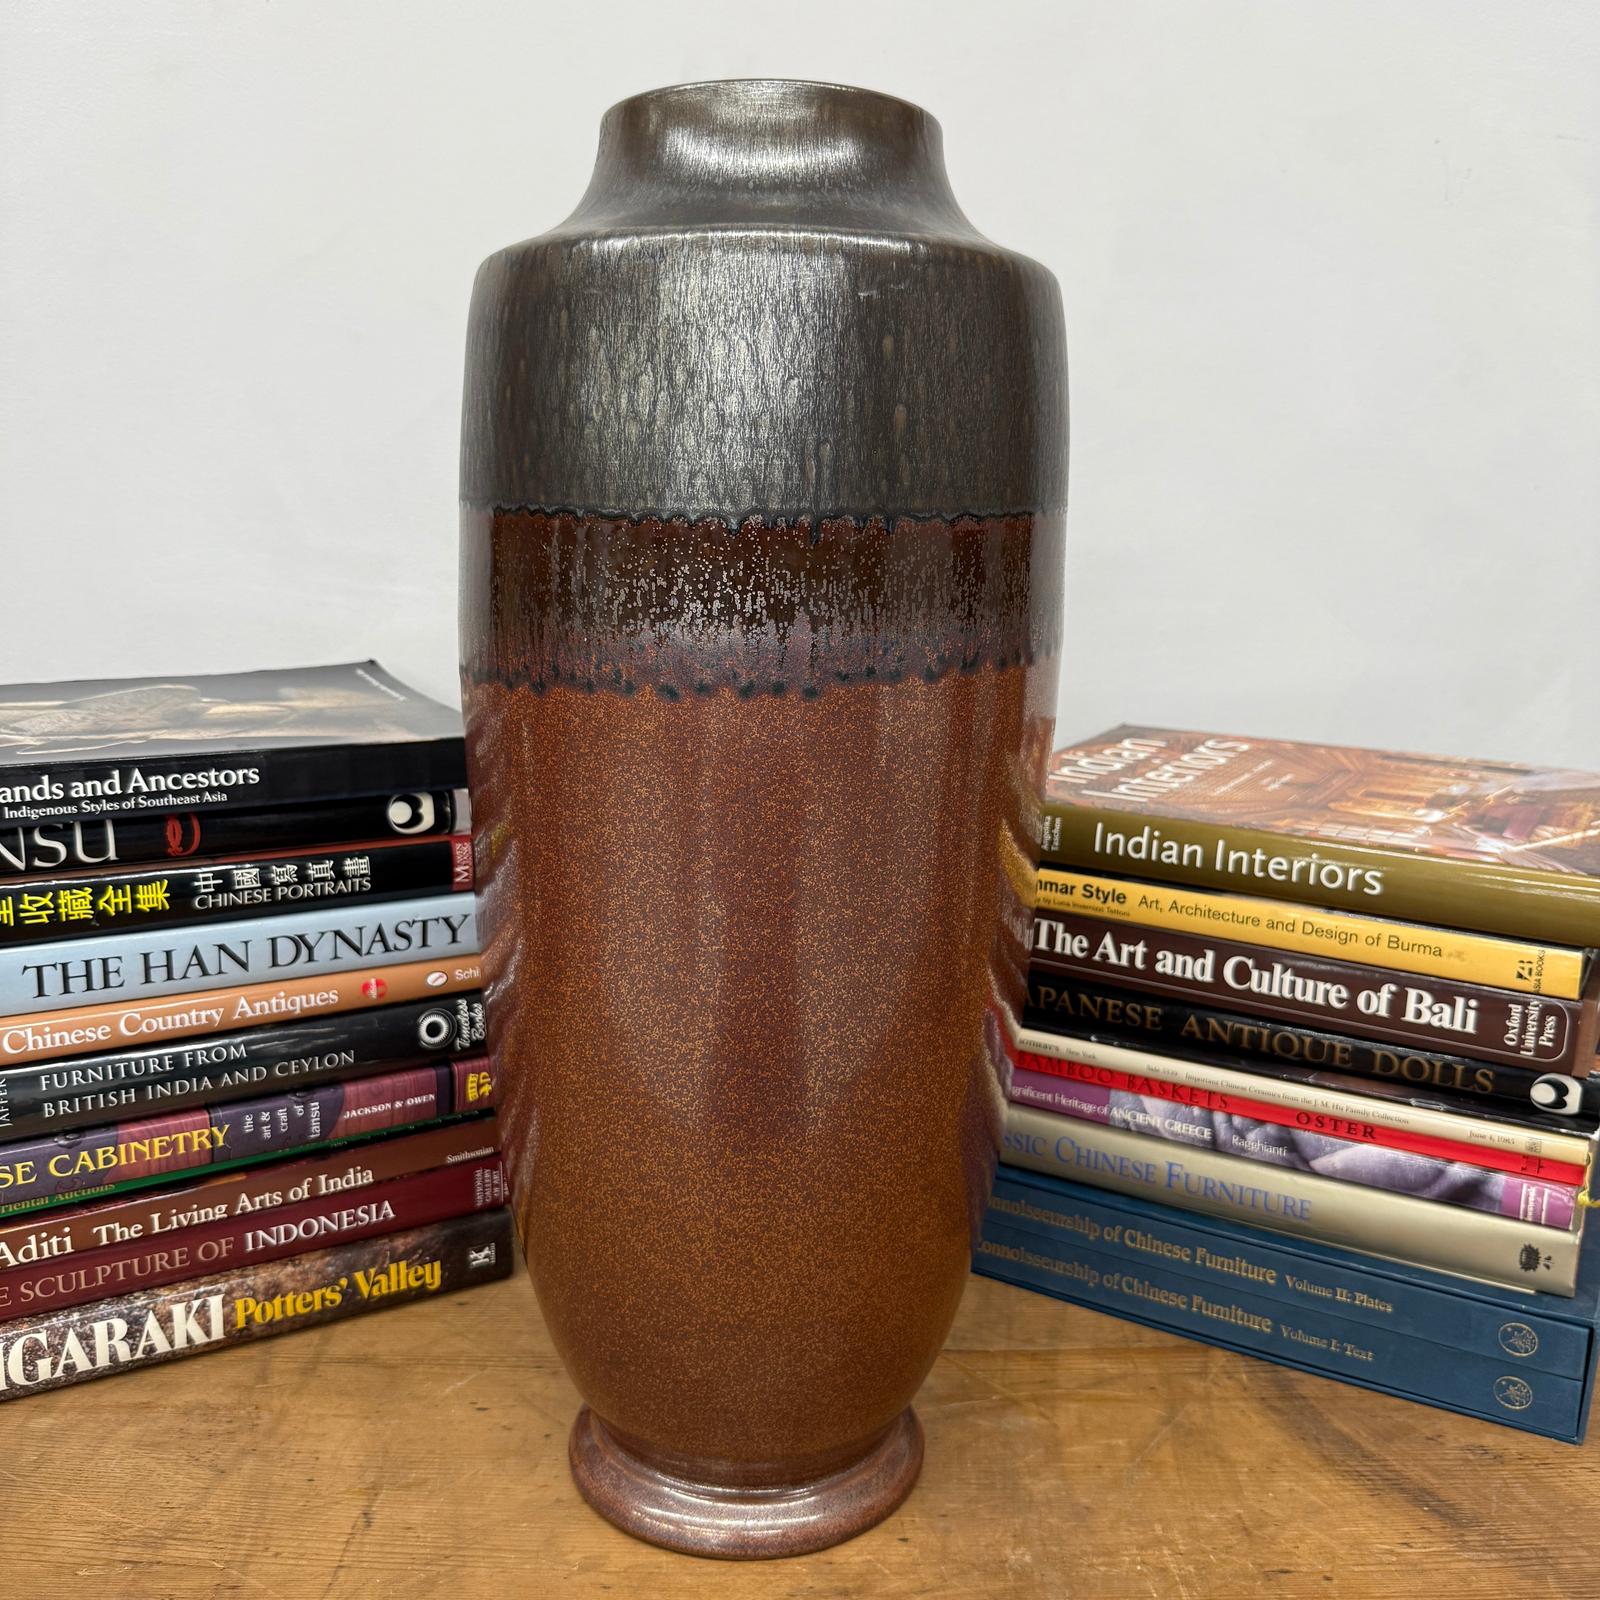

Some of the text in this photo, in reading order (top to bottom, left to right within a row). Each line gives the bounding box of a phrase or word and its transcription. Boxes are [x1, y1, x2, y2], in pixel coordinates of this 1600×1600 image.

[0, 766, 260, 804] ands and Ancestors
[1048, 738, 1168, 784] Indian
[1080, 738, 1250, 802] Interiors
[4, 791, 228, 820] Indigenous Styles of Southeast Asia
[1094, 822, 1384, 896] Indian Interiors
[194, 876, 372, 910] CHINESE PORTRAITS
[1082, 883, 1127, 904] Style
[1138, 895, 1443, 957] Art, Architecture and Design of Burma
[21, 913, 471, 999] THE HAN DYNASTY
[1035, 917, 1481, 1035] The Art and Culture of Bali
[3, 990, 340, 1055] Chinese Country Antiques
[454, 997, 470, 1050] Timeless
[470, 1003, 485, 1041] Books
[1503, 1003, 1523, 1046] Oxford
[1520, 1000, 1544, 1057] University
[1538, 1015, 1557, 1047] Press
[40, 1044, 248, 1091] FURNITURE FROM
[1180, 1013, 1353, 1068] ANTIQUE
[1371, 1050, 1495, 1095] DOLLS
[43, 1049, 355, 1118] BRITISH INDIA AND CEYLON
[344, 1093, 436, 1119] JACKSON & OWEN
[1017, 1050, 1377, 1140] BAMBOO BASKETS OSTER
[244, 1113, 254, 1133] the
[260, 1111, 271, 1140] art &
[277, 1108, 288, 1132] craft
[294, 1104, 304, 1117] of
[308, 1101, 320, 1139] tansu
[1054, 1092, 1097, 1114] Heritage
[1097, 1104, 1110, 1115] of
[1110, 1106, 1161, 1128] ANCIENT
[1164, 1118, 1212, 1140] GREECE
[0, 1124, 230, 1188] SE CABINETRY
[446, 1144, 495, 1164] Smithsonian
[1055, 1136, 1157, 1185] CHINESE
[1166, 1161, 1312, 1221] FURNITURE
[92, 1166, 374, 1246] The Living Arts of India
[0, 1227, 76, 1269] Aditi
[20, 1247, 190, 1302] SCULPTURE
[198, 1236, 235, 1262] OF
[244, 1199, 396, 1251] INDONESIA
[1103, 1225, 1123, 1242] of
[1124, 1228, 1191, 1263] Chinese
[1195, 1247, 1277, 1284] Furniture
[1285, 1275, 1332, 1297] Volume
[1335, 1287, 1352, 1302] II:
[1354, 1292, 1393, 1313] Plates
[234, 1259, 442, 1329] Potters' Valley
[977, 1241, 1100, 1288] onnoisseurship
[1103, 1273, 1122, 1289] of
[1122, 1276, 1187, 1310] Chinese
[1191, 1295, 1273, 1333] Furniture
[1279, 1324, 1328, 1348] Volume
[1344, 1343, 1376, 1361] Text
